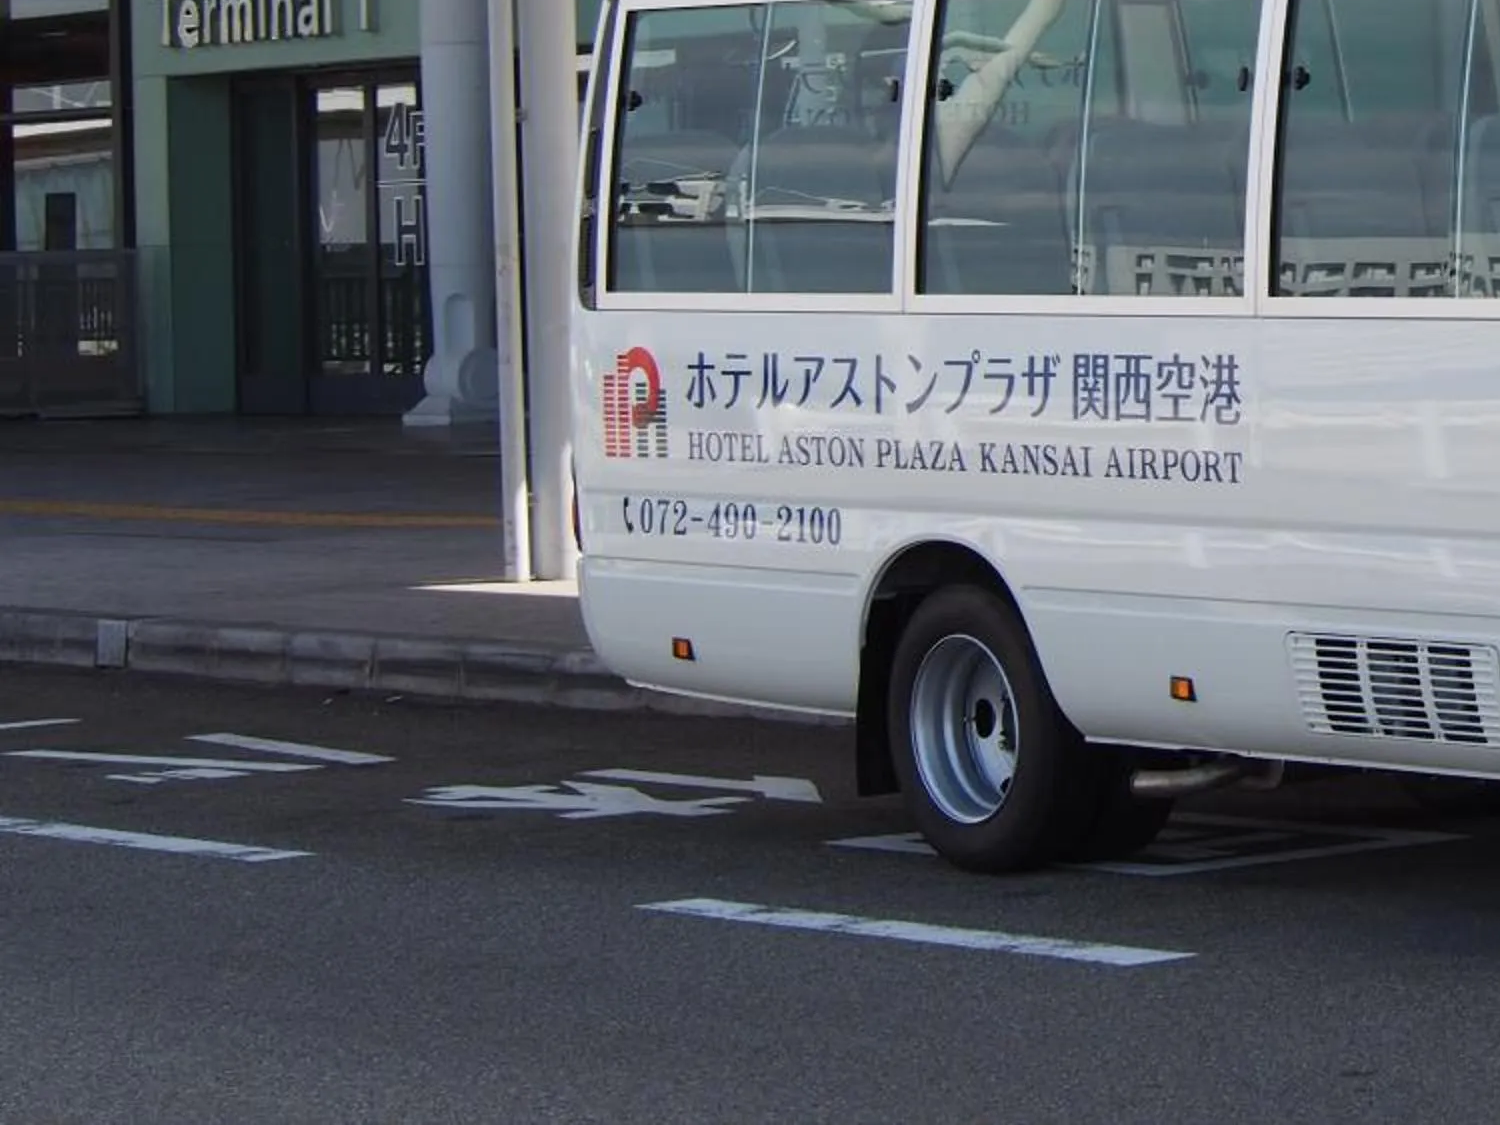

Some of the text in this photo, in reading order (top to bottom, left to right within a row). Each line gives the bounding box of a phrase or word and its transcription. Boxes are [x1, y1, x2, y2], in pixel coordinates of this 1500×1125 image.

[687, 430, 1244, 484] HOTEL ASTON PLAZA KANSAI AIRPORT
[639, 497, 842, 546] 072-490-2100
